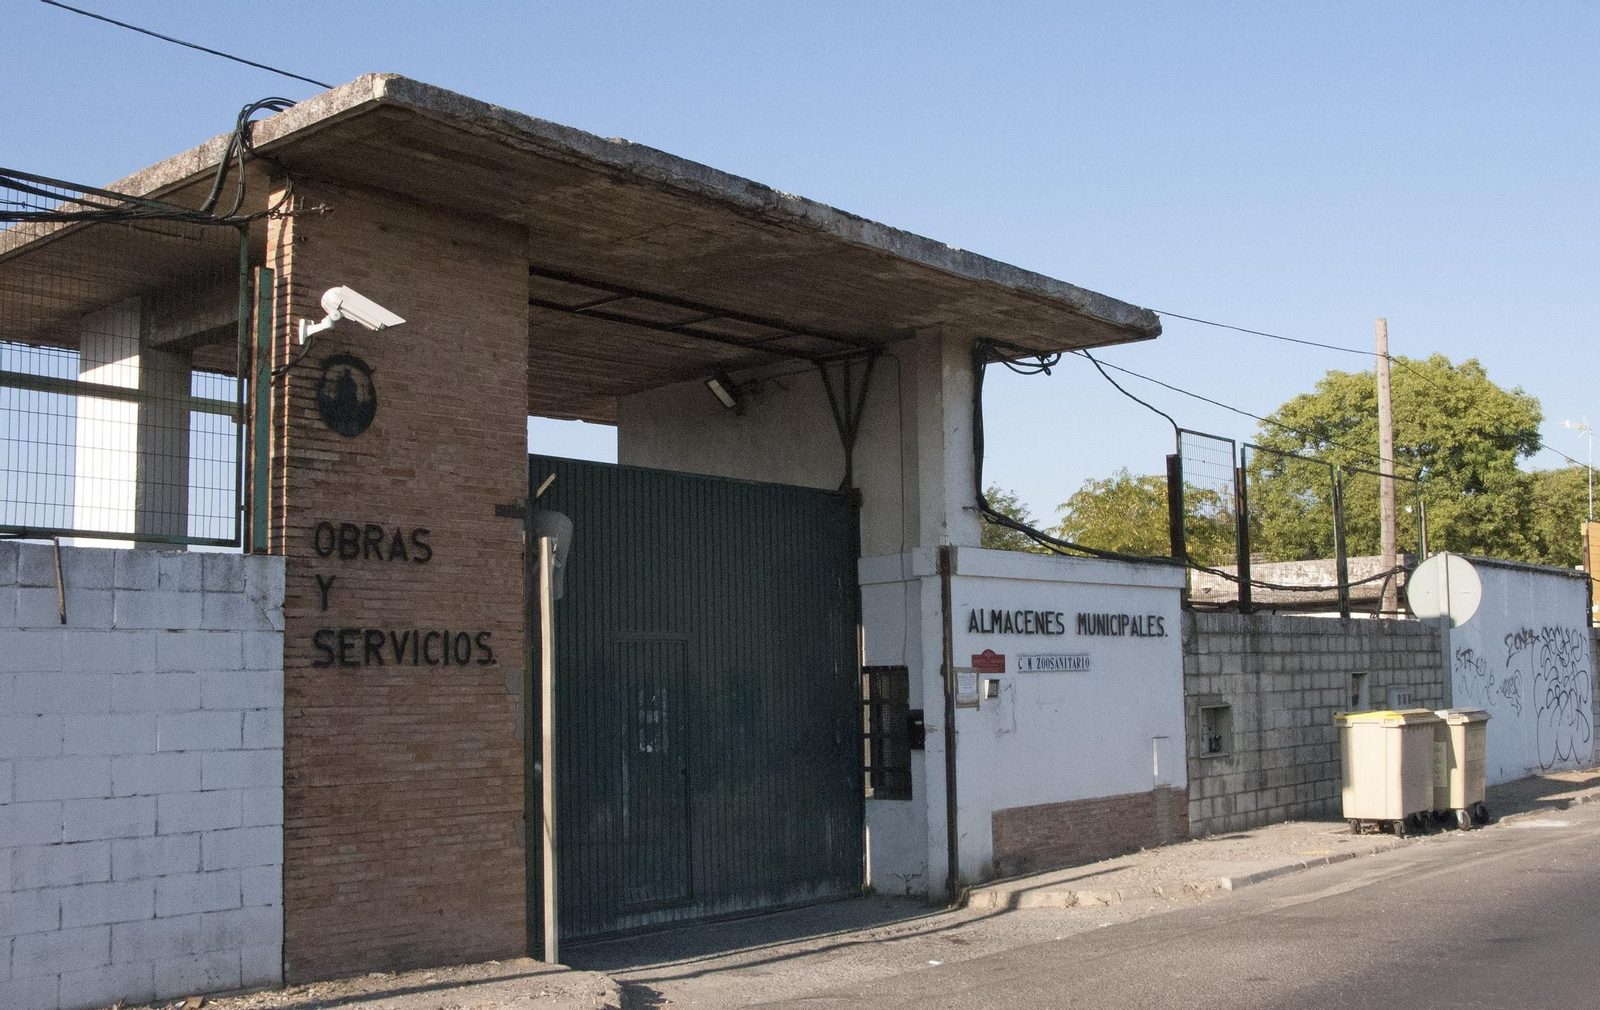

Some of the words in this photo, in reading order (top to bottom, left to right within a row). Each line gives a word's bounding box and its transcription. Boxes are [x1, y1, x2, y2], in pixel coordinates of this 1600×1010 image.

[314, 520, 433, 564] OBRAS
[315, 573, 336, 611] Y
[968, 608, 1065, 635] ALMACENES
[1077, 612, 1168, 638] MUNICIPALES.
[1037, 656, 1090, 670] ZOOSANITARIO
